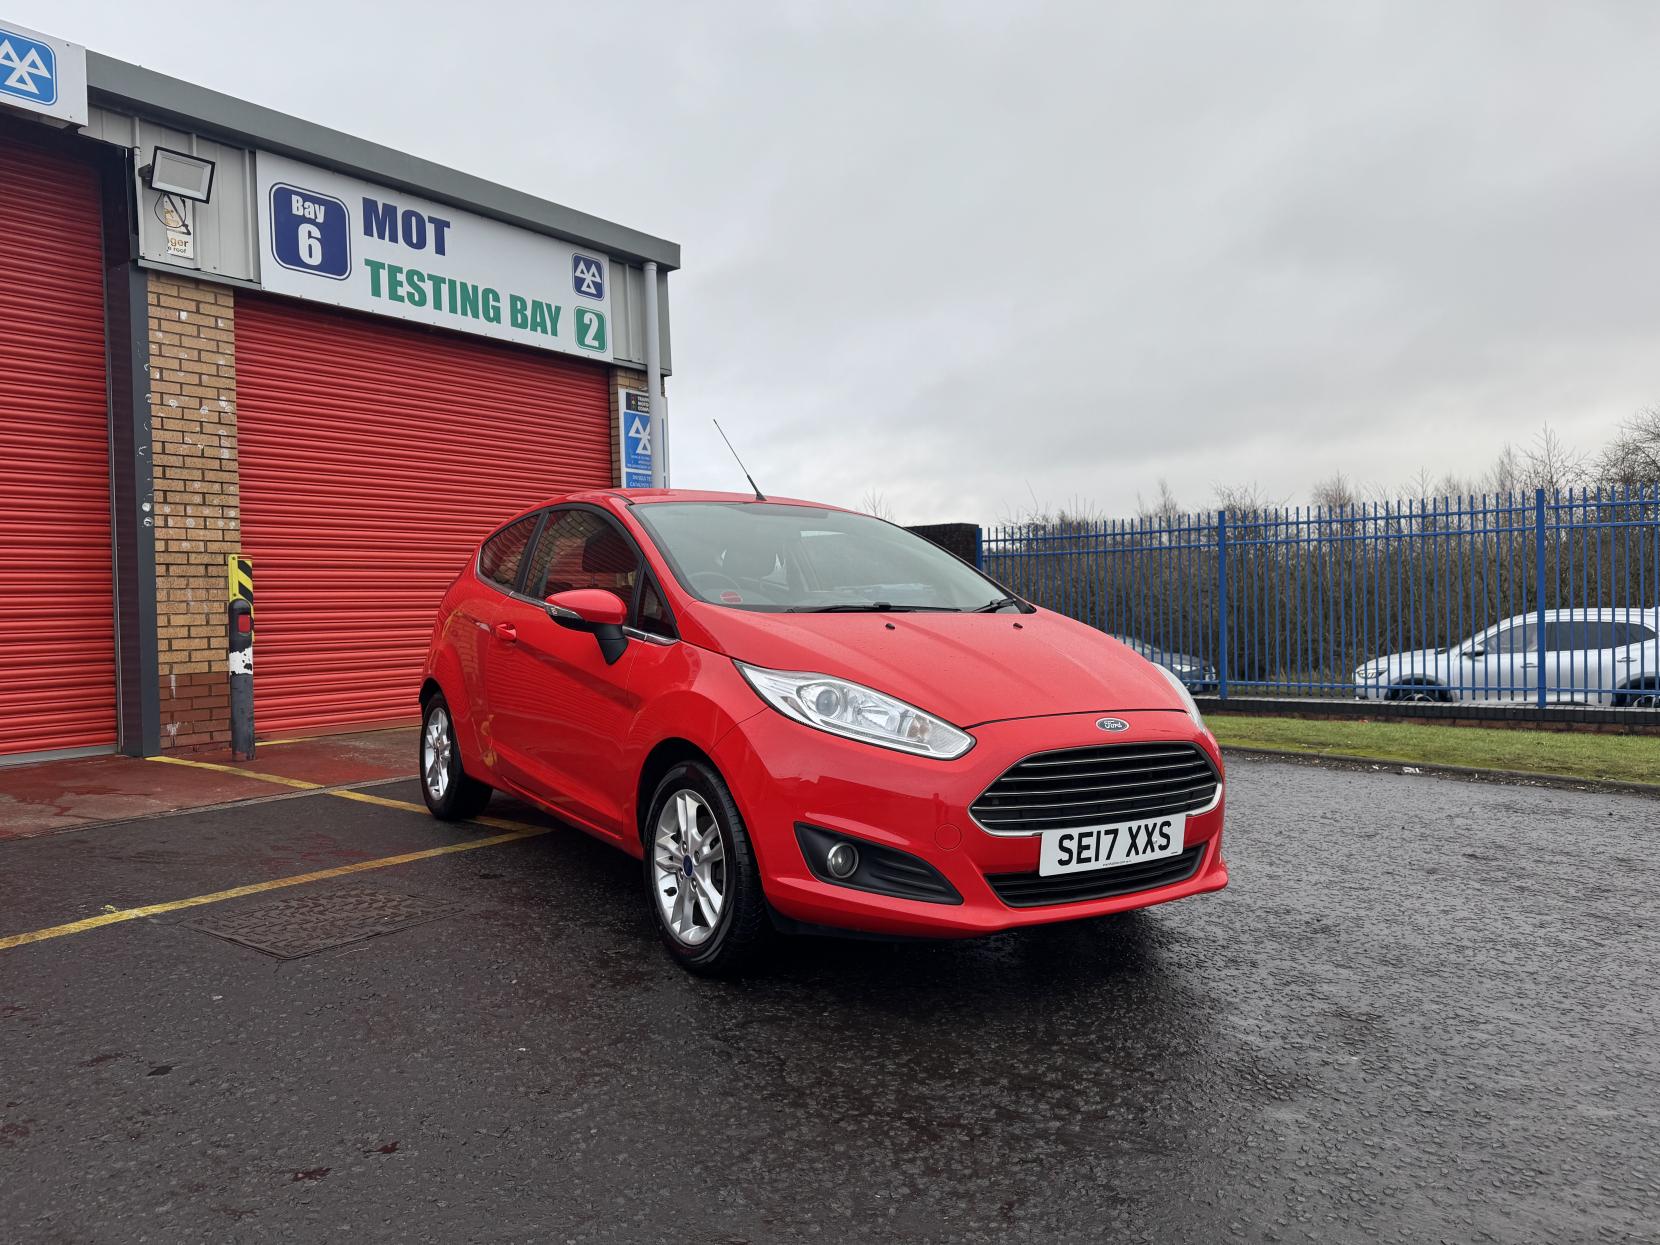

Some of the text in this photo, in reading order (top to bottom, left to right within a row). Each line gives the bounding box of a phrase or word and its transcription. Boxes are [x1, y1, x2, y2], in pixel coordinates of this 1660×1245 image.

[291, 194, 325, 223] Bay
[362, 196, 451, 257] MOT
[298, 223, 322, 266] 6
[364, 258, 562, 337] TESTING BAY
[583, 312, 600, 348] 2
[1057, 820, 1172, 867] SE17 XXS
